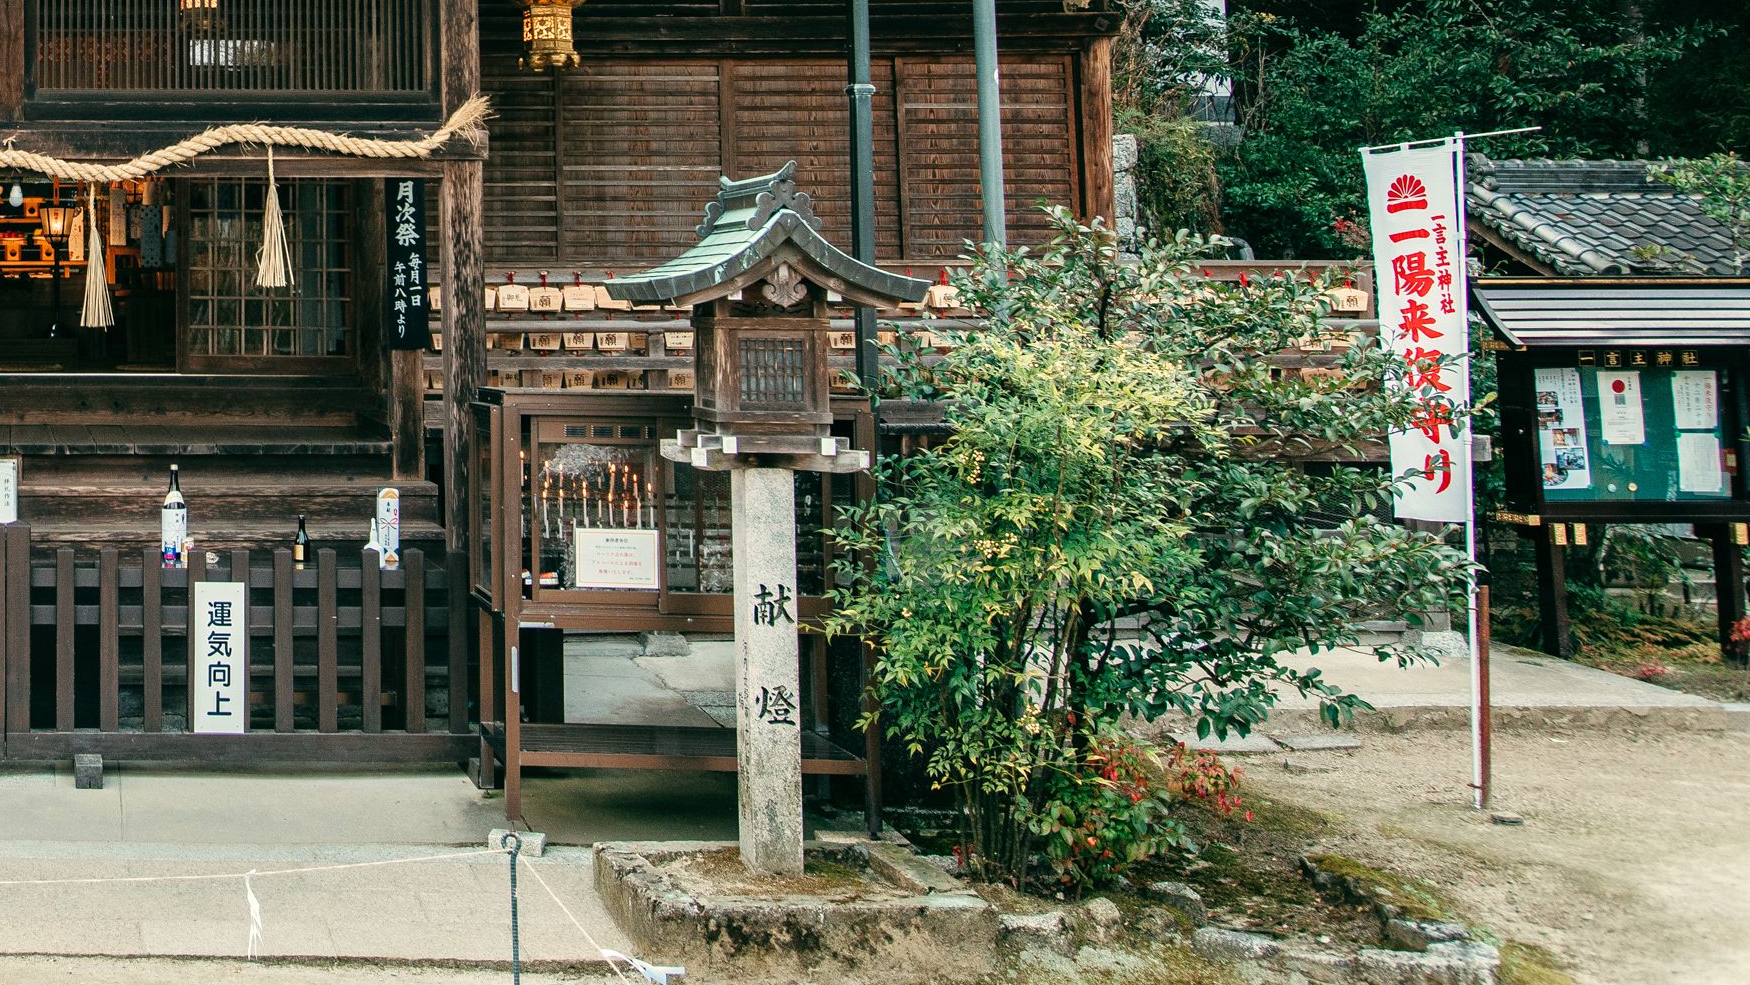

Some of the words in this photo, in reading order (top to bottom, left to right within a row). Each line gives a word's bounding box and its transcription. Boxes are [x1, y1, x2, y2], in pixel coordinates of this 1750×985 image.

[395, 180, 420, 247] 月次祭
[393, 261, 408, 339] 午前八時より
[408, 252, 423, 307] 毎月一日
[1430, 214, 1456, 315] 一言主神社
[1579, 351, 1698, 365] 一言主神社
[207, 601, 232, 716] 運気向上
[753, 583, 796, 727] 献燈
